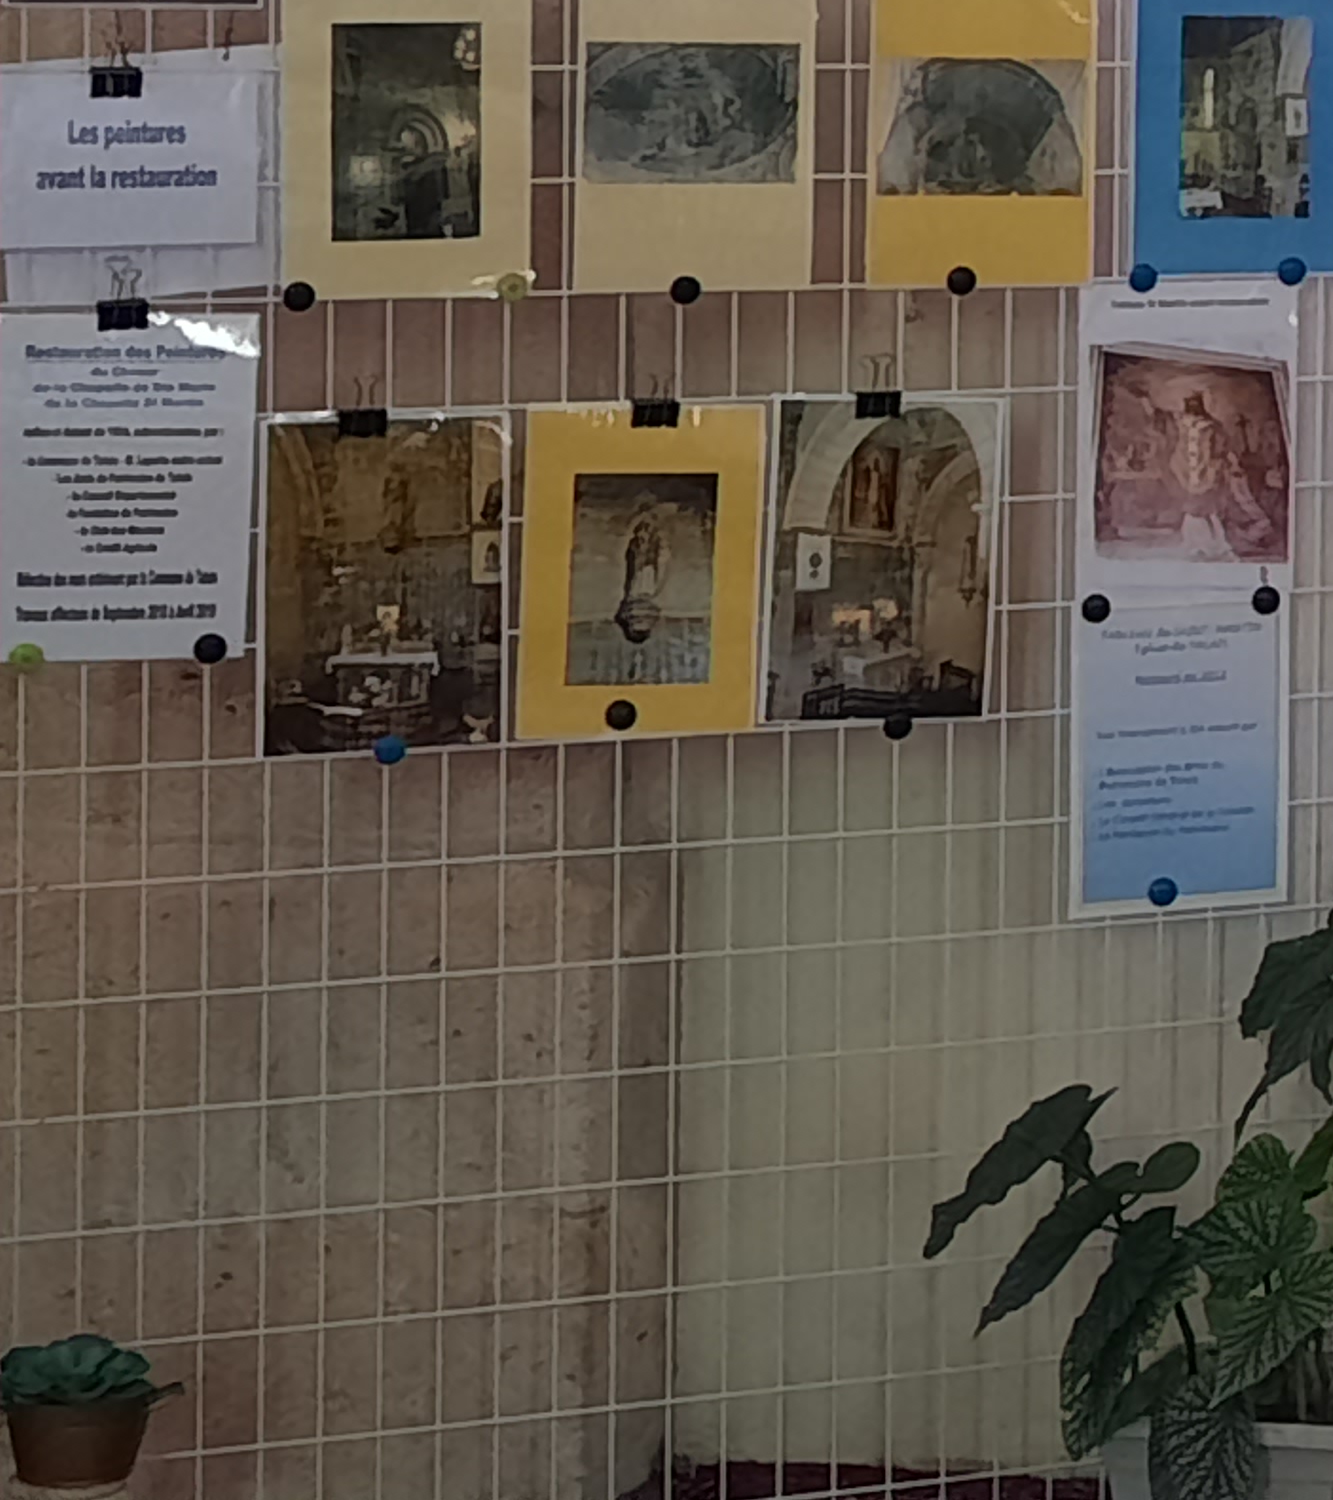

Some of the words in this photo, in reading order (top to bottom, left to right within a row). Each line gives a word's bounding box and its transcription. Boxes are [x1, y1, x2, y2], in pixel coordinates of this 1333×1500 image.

[67, 119, 99, 145] Les
[103, 119, 187, 151] peintures
[36, 167, 85, 191] avant
[90, 164, 107, 190] la
[110, 164, 218, 190] restauration
